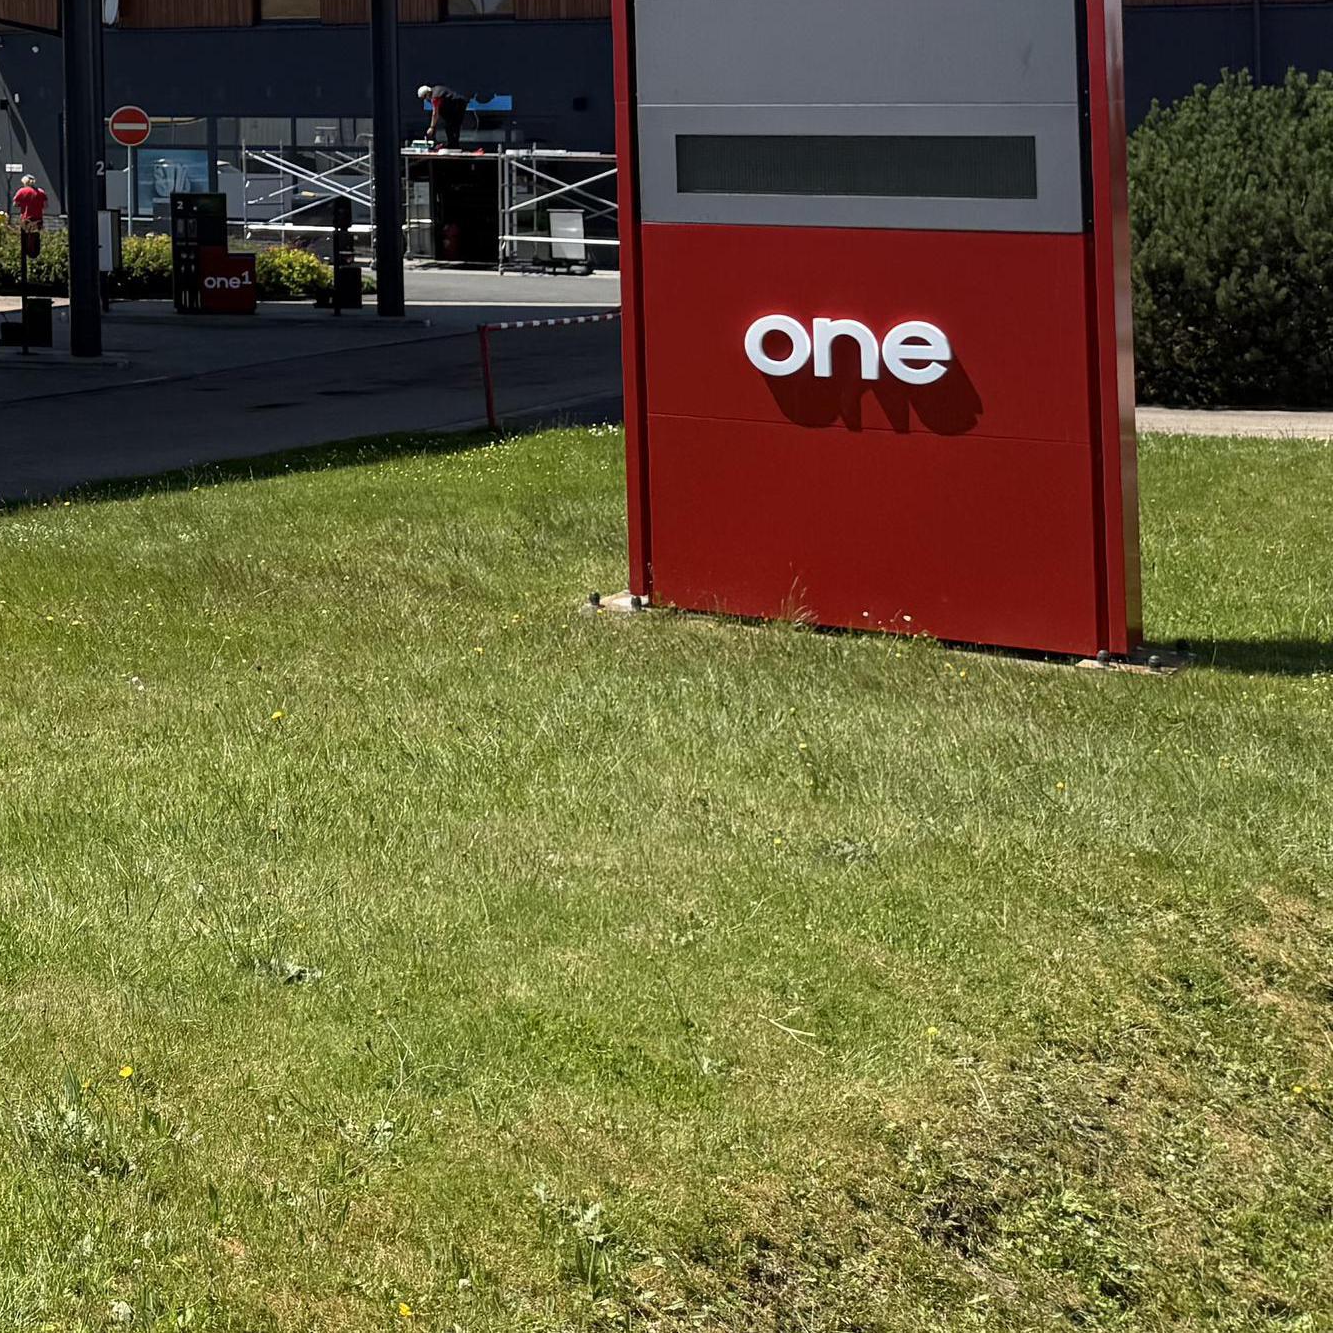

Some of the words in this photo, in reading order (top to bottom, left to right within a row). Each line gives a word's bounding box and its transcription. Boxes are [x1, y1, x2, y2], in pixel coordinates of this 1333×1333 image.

[96, 160, 105, 176] 2
[176, 201, 184, 210] 2
[744, 314, 952, 385] one
